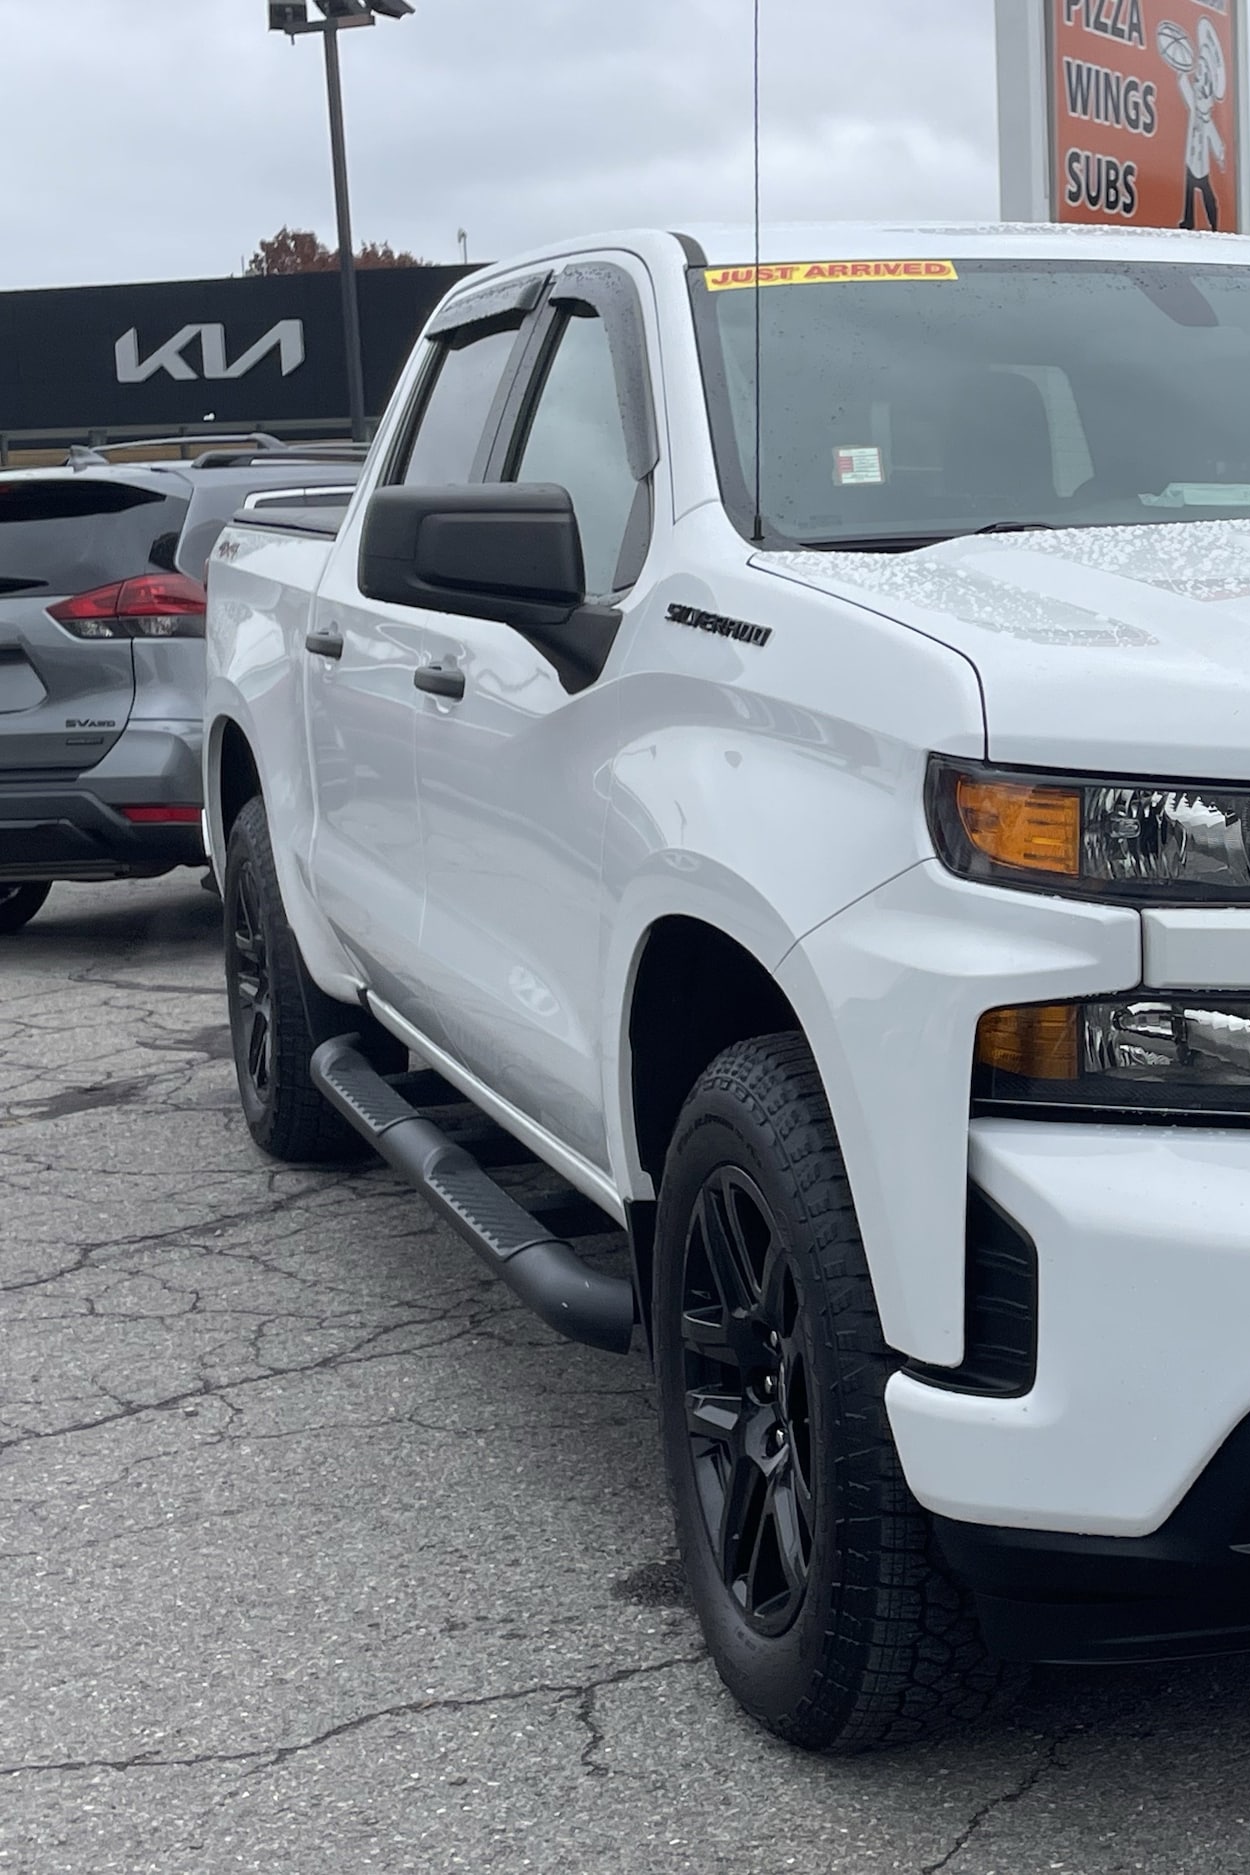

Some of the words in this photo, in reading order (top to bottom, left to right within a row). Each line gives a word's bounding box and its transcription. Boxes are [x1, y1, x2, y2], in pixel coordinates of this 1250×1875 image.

[1063, 57, 1156, 136] WINGS
[1065, 148, 1137, 217] SUBS
[711, 266, 799, 286] JUST
[804, 262, 951, 279] ARRIVED
[115, 319, 305, 383] KIA
